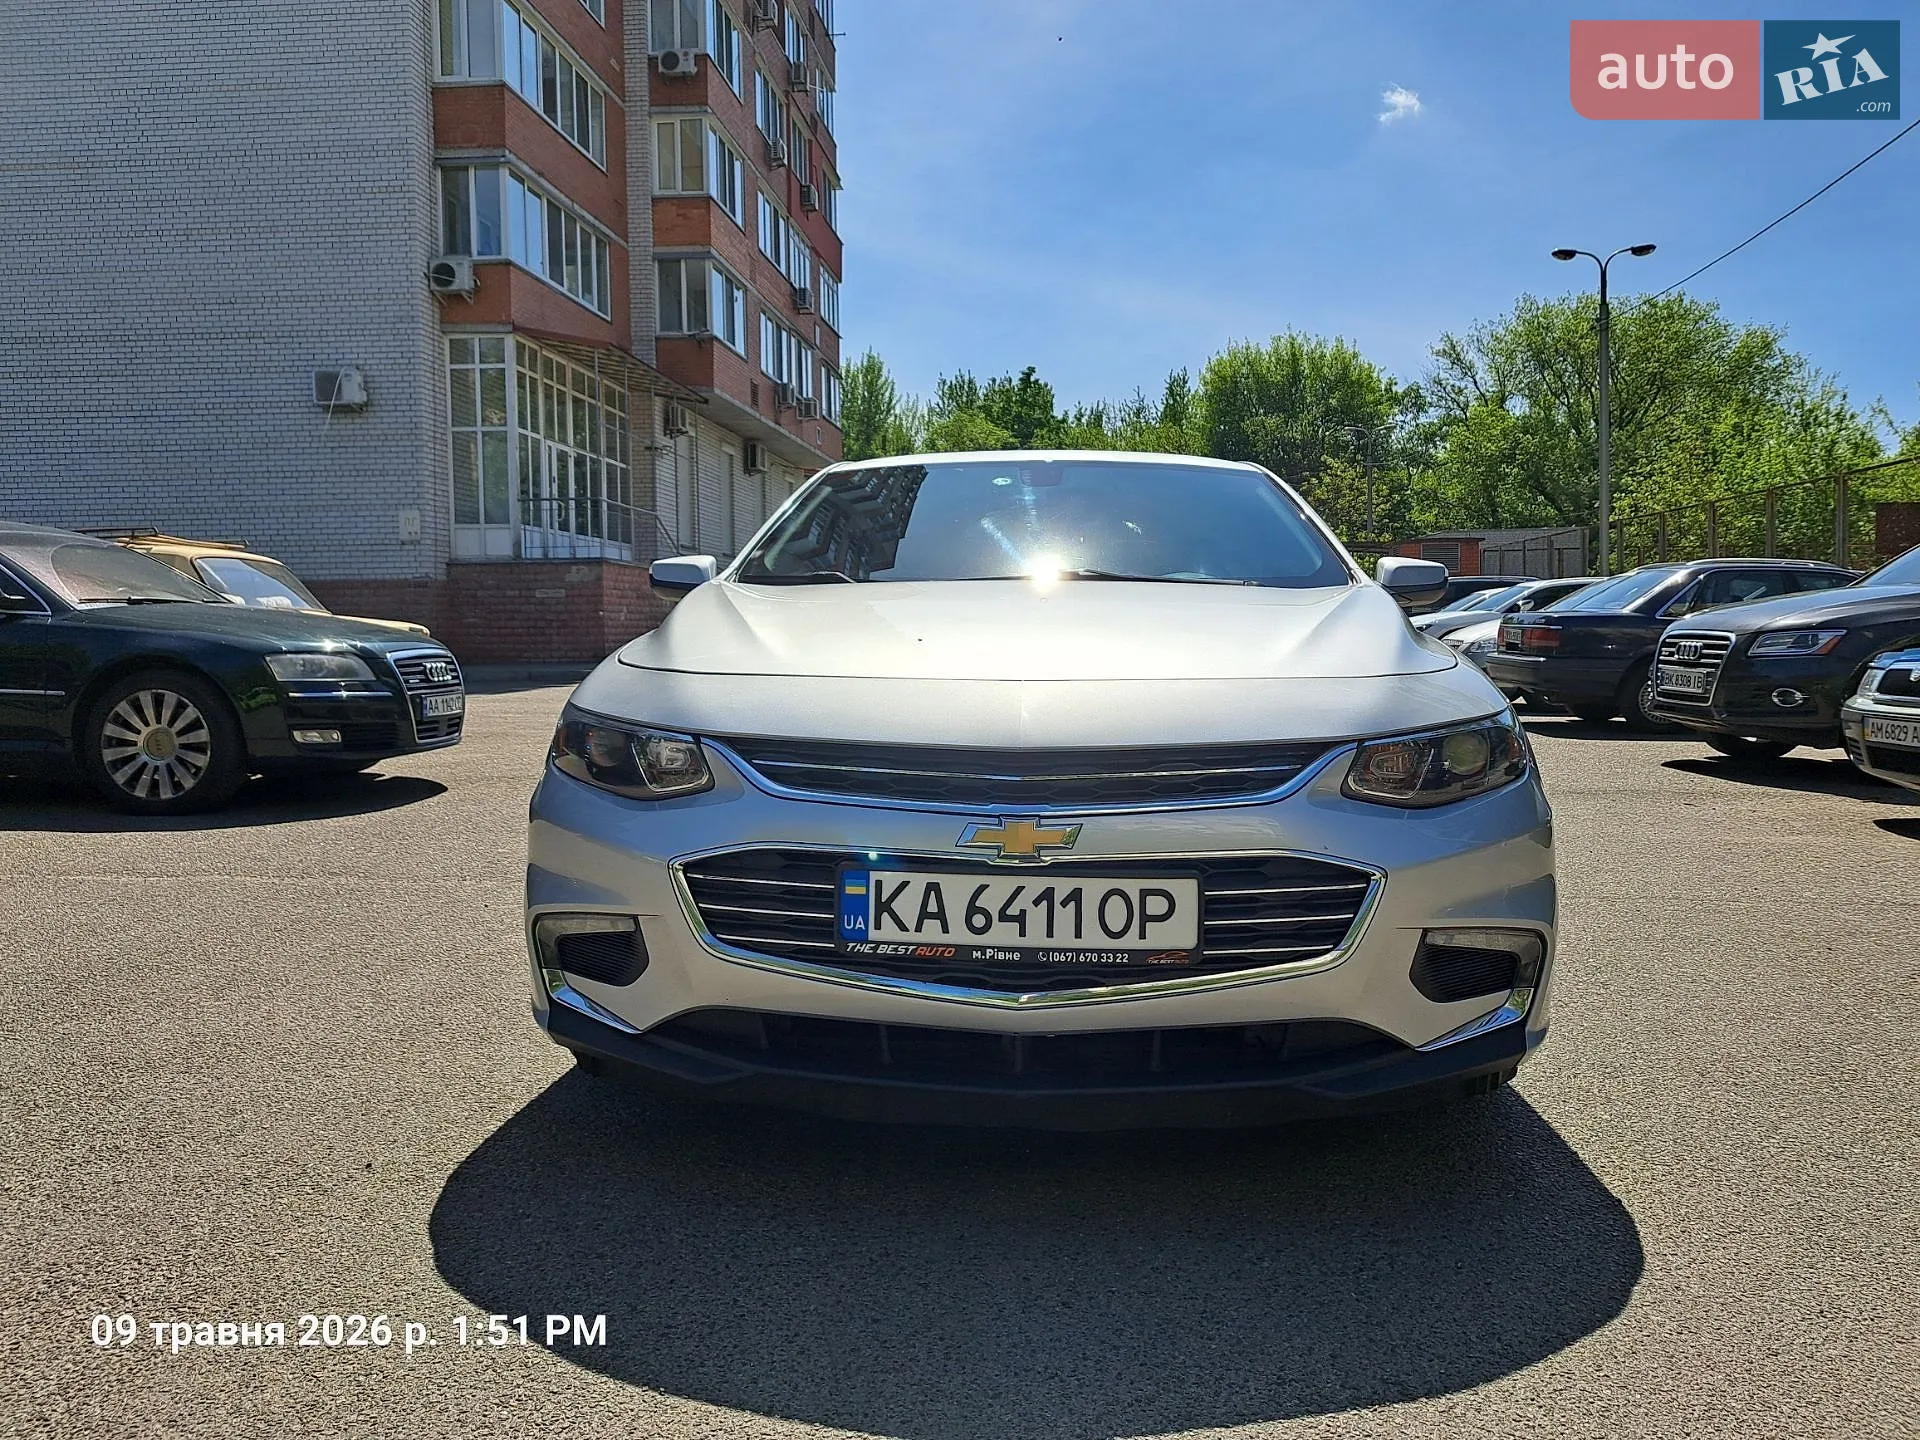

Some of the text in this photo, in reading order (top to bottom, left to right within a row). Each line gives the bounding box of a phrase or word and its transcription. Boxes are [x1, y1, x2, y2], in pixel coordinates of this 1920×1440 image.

[1870, 721, 1884, 739] AM
[1884, 723, 1909, 742] 6829
[873, 879, 1177, 940] KA 6411 OP
[844, 914, 866, 930] UA
[846, 942, 876, 953] THE
[1049, 951, 1129, 963] (067) 670 33 22
